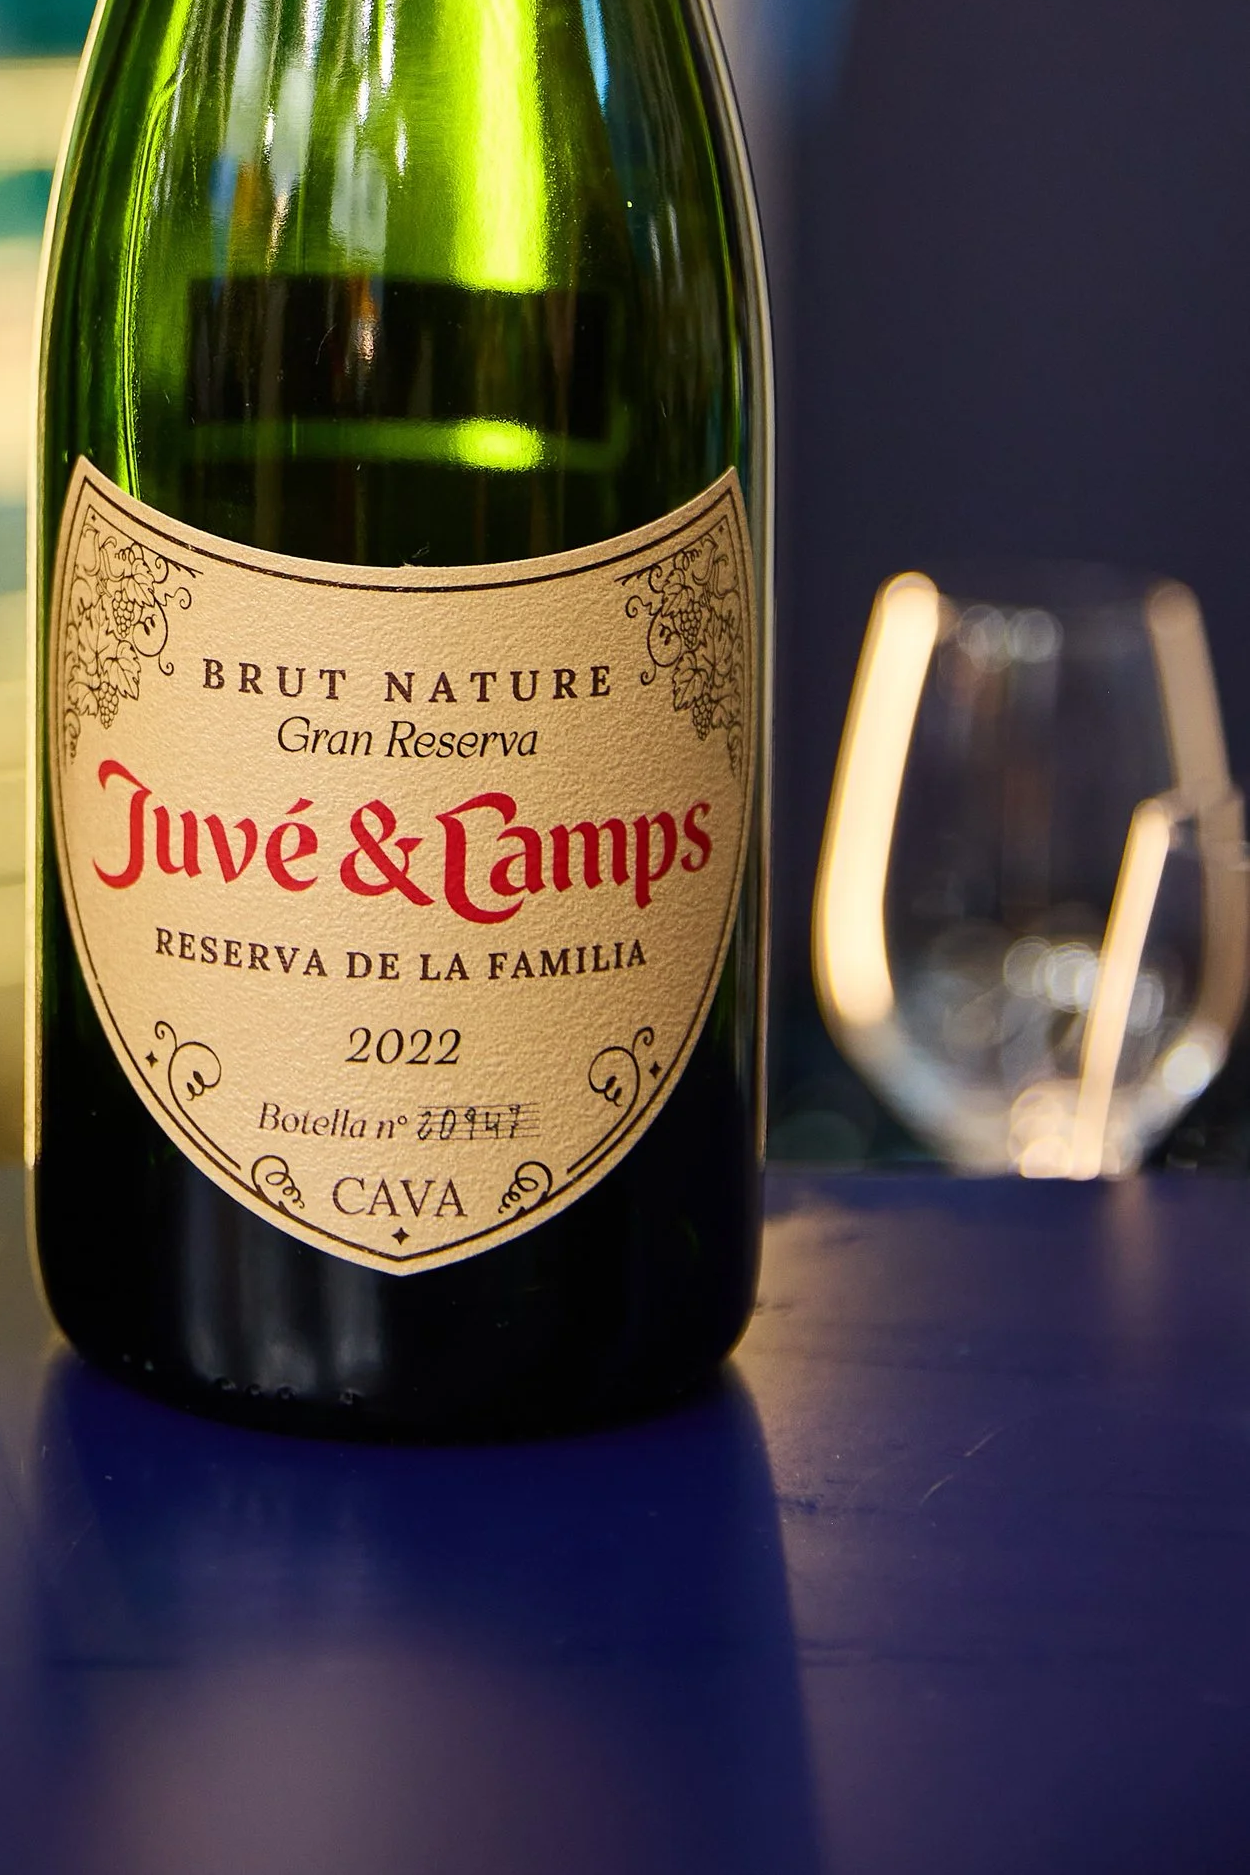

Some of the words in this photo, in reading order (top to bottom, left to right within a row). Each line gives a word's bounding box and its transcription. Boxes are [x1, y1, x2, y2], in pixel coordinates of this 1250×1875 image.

[202, 657, 347, 701] BRUT
[385, 666, 613, 703] NATURE
[277, 715, 373, 756] Gran
[385, 720, 538, 759] Reserva
[93, 759, 320, 892] Juvé
[340, 798, 436, 907] &
[436, 791, 712, 925] Camps
[155, 927, 327, 978] RESERVA
[346, 951, 400, 980] DE
[419, 952, 469, 981] LA
[487, 938, 647, 980] FAMILIA
[344, 1027, 461, 1066] 2022
[258, 1101, 366, 1140] Botella
[332, 1176, 468, 1218] CAVA
